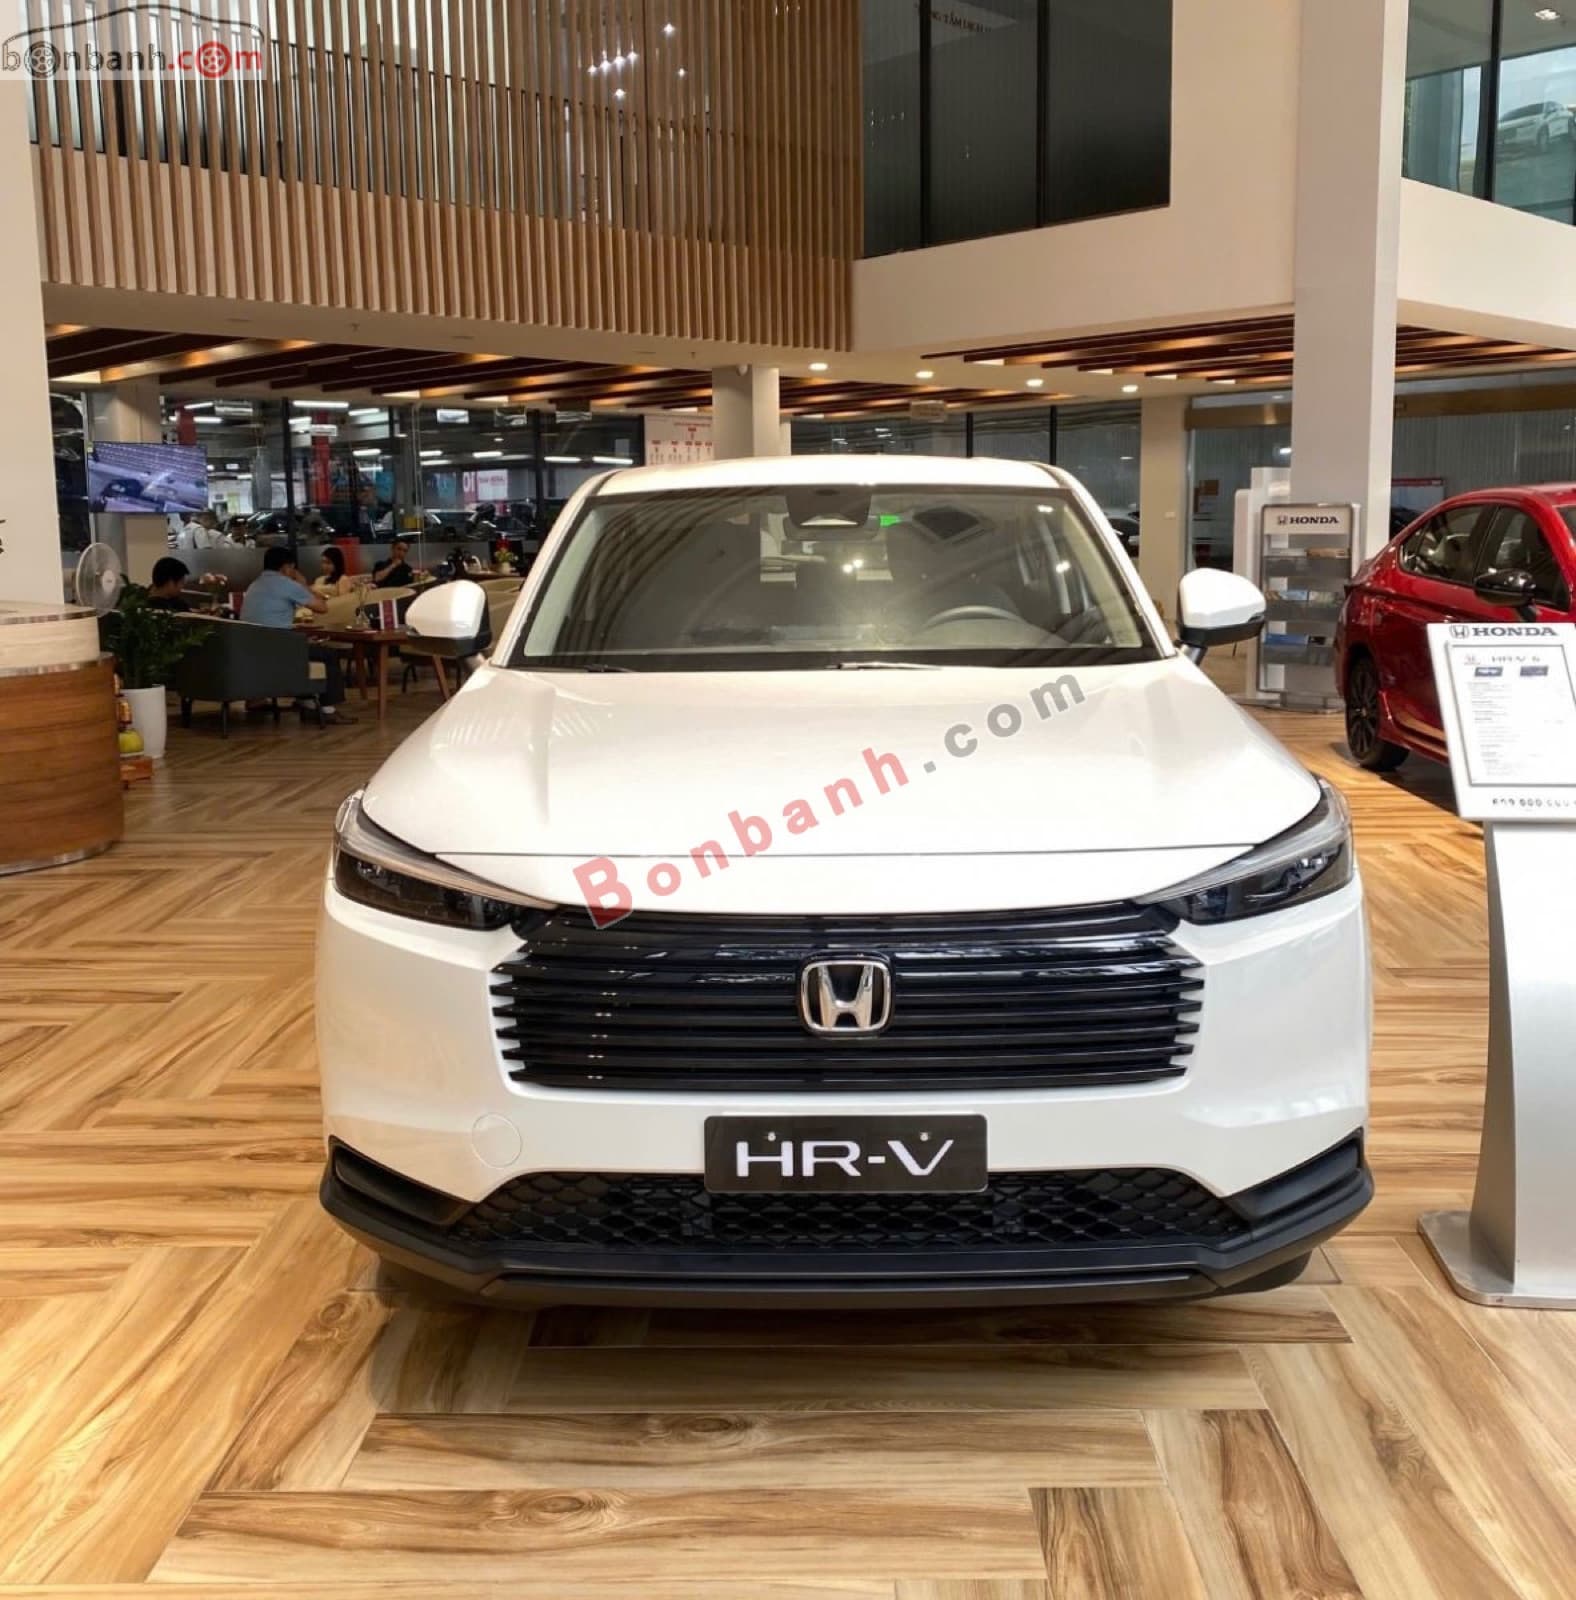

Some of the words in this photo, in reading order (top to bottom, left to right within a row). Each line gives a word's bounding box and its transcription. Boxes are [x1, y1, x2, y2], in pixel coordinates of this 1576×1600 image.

[1289, 516, 1339, 524] HONDA
[1472, 627, 1558, 637] HONDA
[737, 1140, 954, 1177] HR-V
